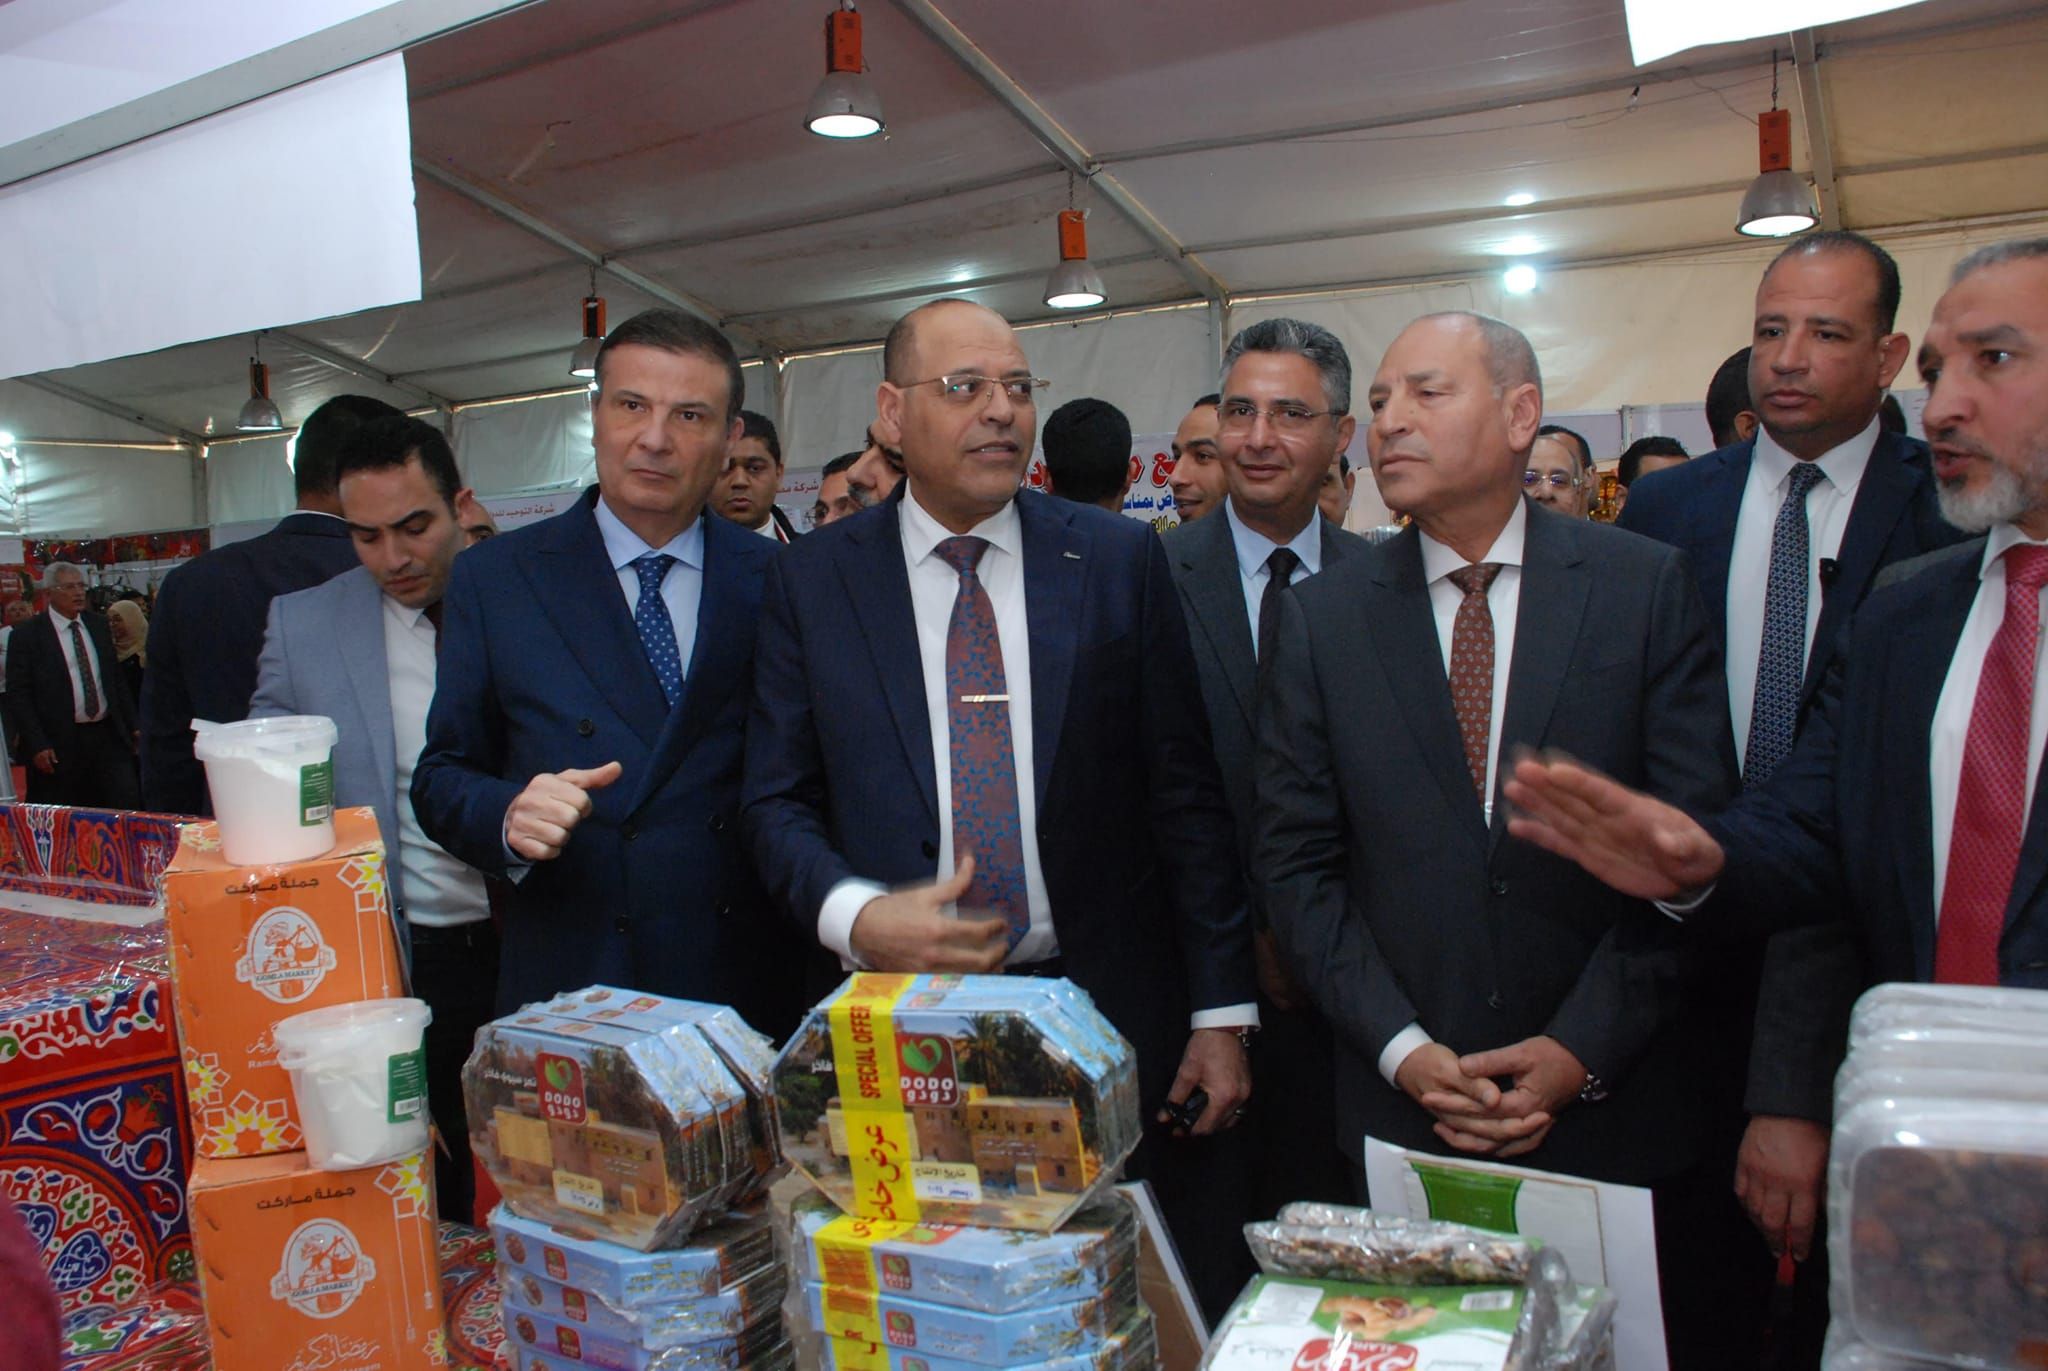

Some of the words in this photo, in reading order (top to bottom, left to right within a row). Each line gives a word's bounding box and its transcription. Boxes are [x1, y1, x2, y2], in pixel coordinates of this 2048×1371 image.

[850, 1004, 874, 1044] OFFER
[855, 1047, 881, 1099] SPECIAL
[900, 1076, 953, 1090] DODO
[544, 1091, 581, 1108] DODO
